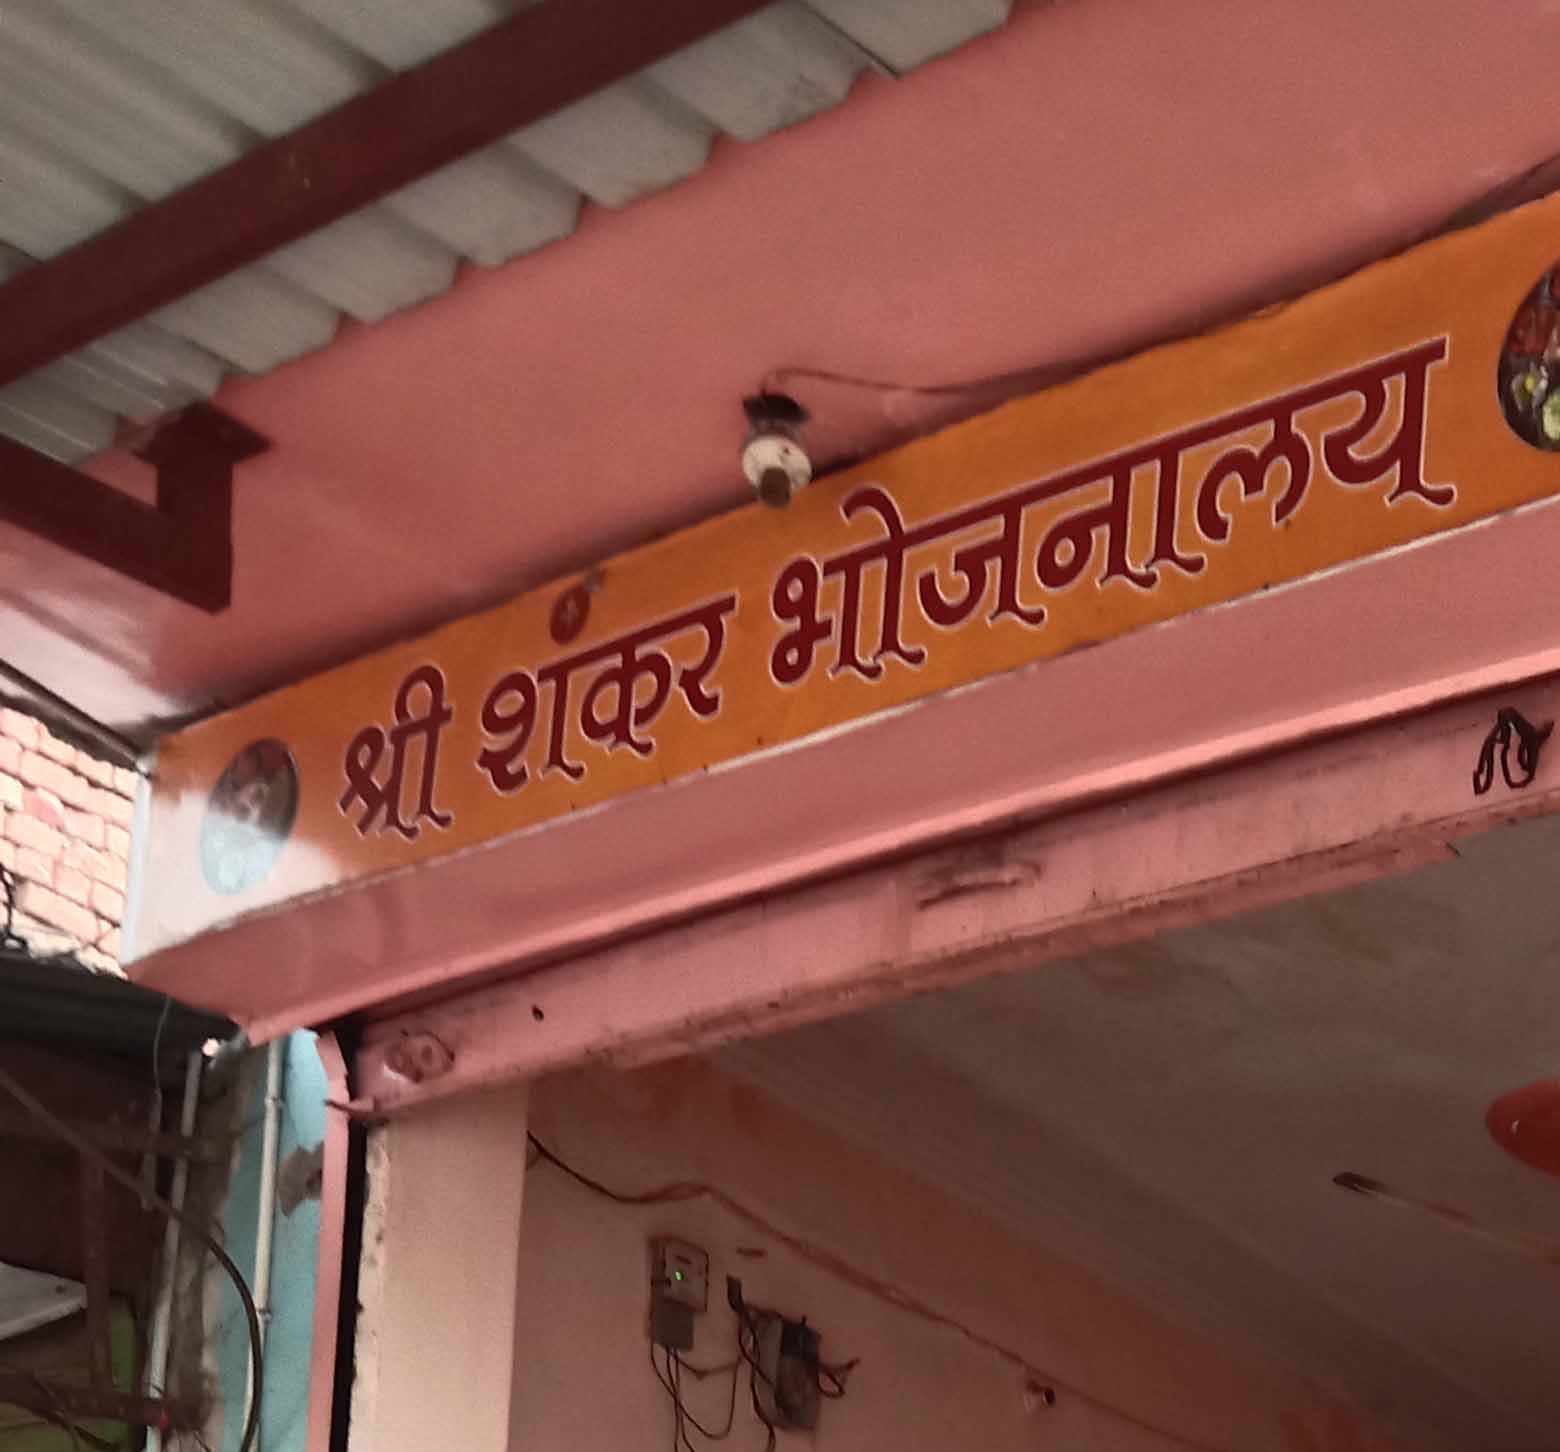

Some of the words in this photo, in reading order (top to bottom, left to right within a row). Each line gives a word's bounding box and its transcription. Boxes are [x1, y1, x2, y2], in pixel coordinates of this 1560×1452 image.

[338, 663, 453, 841] श्री
[476, 586, 740, 796] शंकर
[768, 335, 1458, 688] भोजनालय
